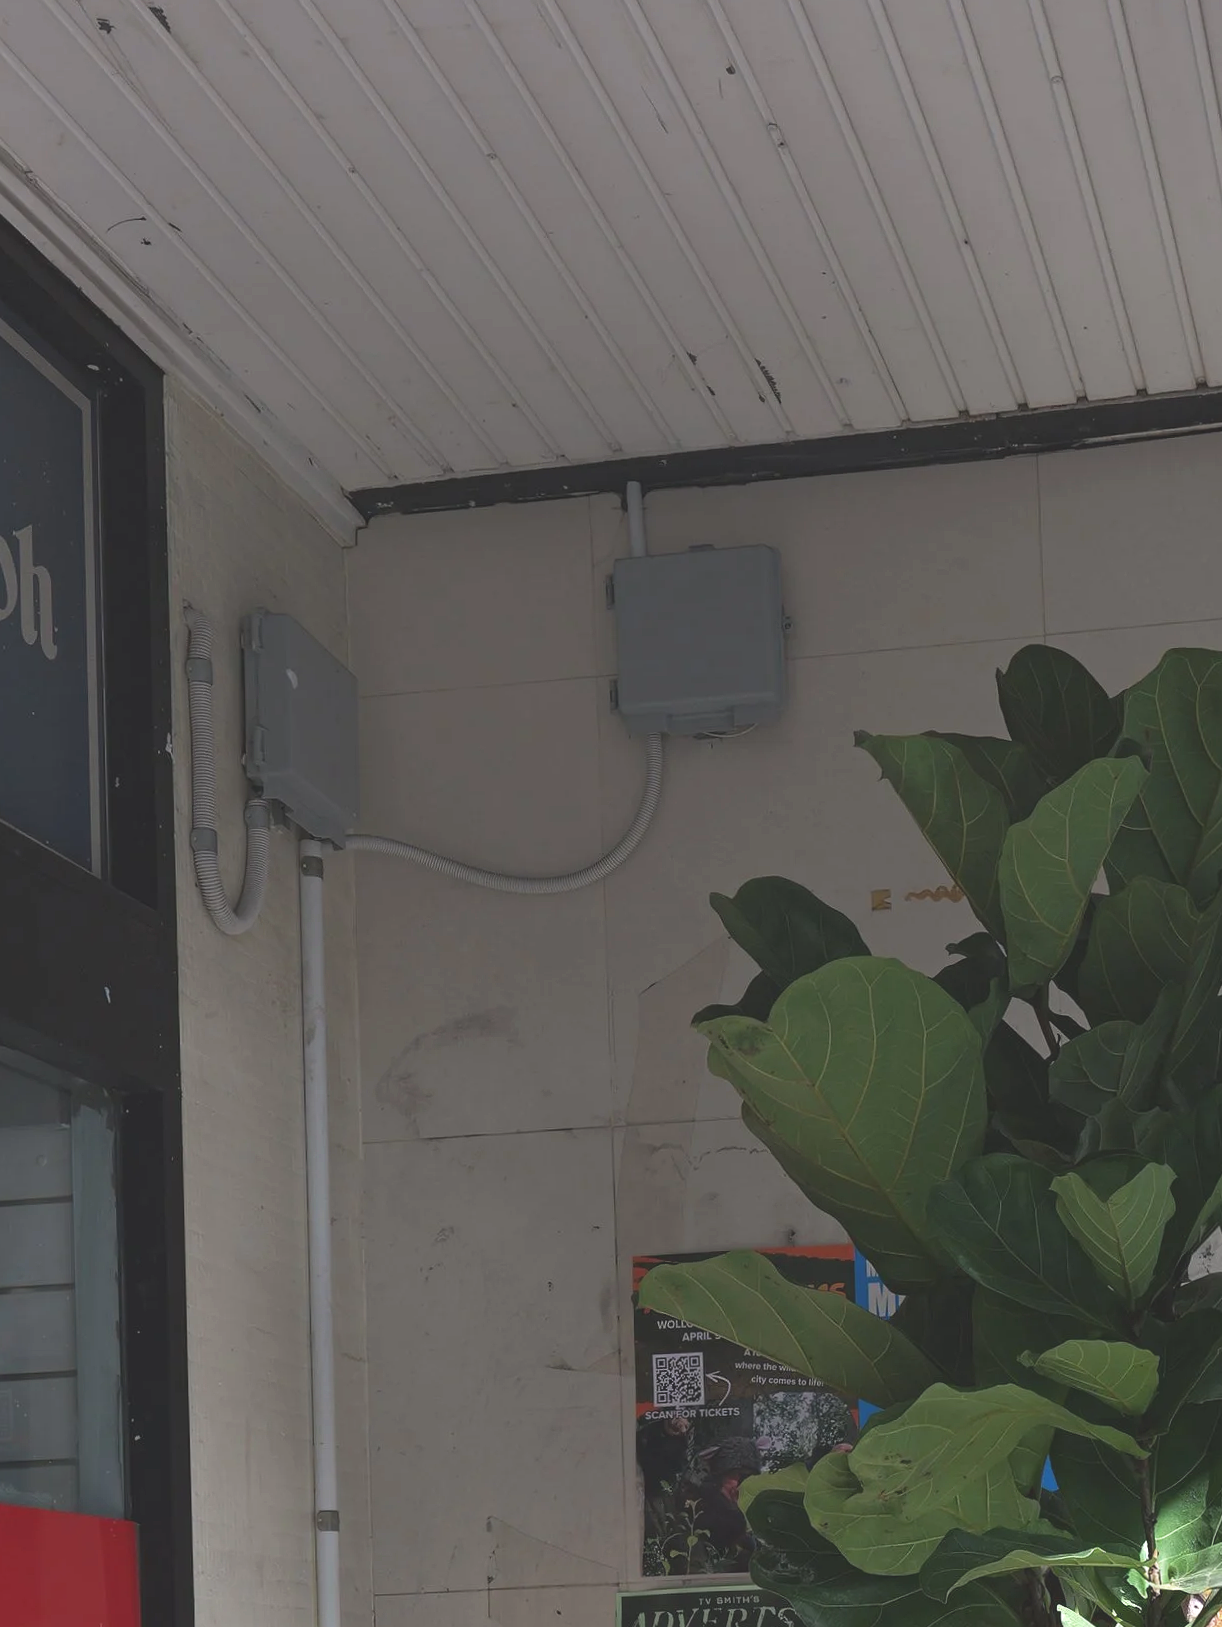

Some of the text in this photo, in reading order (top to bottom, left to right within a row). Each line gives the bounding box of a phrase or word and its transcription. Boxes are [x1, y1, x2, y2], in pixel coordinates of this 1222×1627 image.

[682, 1332, 713, 1342] APRIL
[735, 1362, 777, 1371] where the
[751, 1375, 766, 1385] city
[768, 1378, 796, 1386] comes
[645, 1408, 740, 1420] SCAN FOR TICKETS
[699, 1595, 760, 1606] TV SMITH'S
